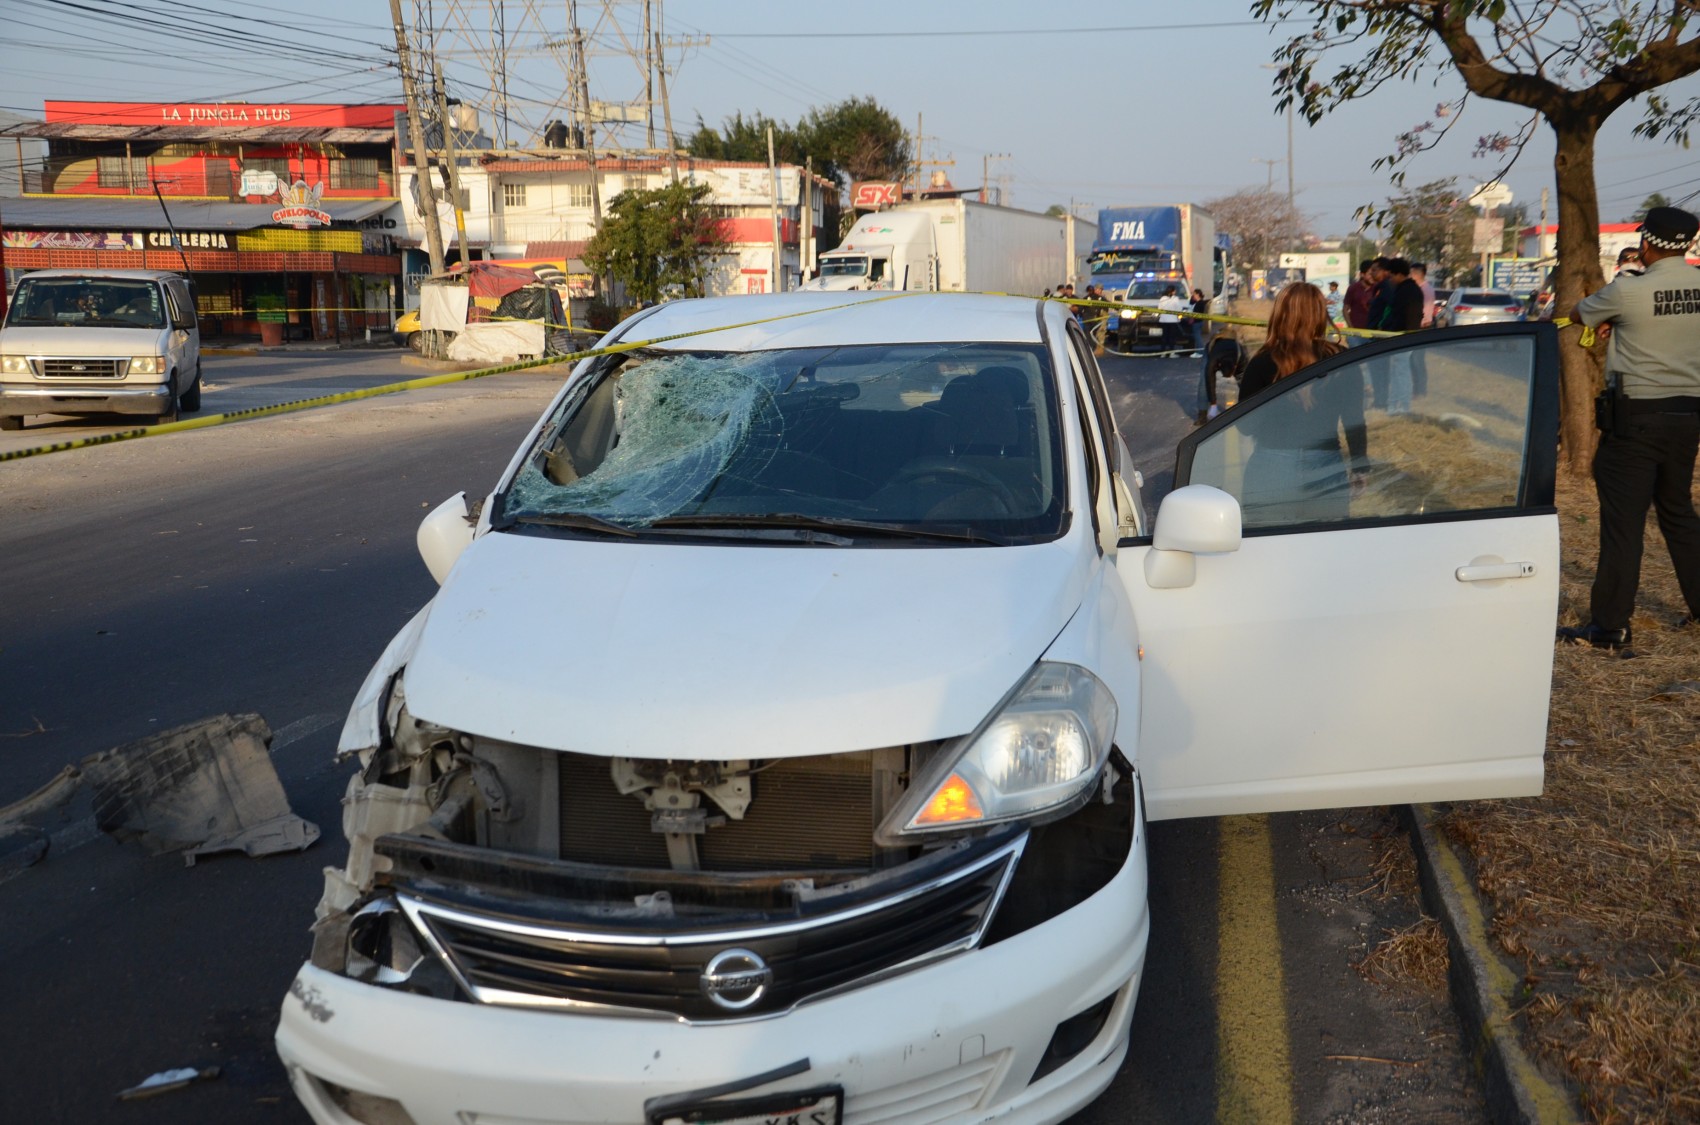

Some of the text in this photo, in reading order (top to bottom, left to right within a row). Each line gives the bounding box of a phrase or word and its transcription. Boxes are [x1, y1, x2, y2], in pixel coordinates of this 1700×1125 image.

[162, 107, 291, 122] LA JUNGLA PLUS
[1110, 221, 1145, 241] FMA
